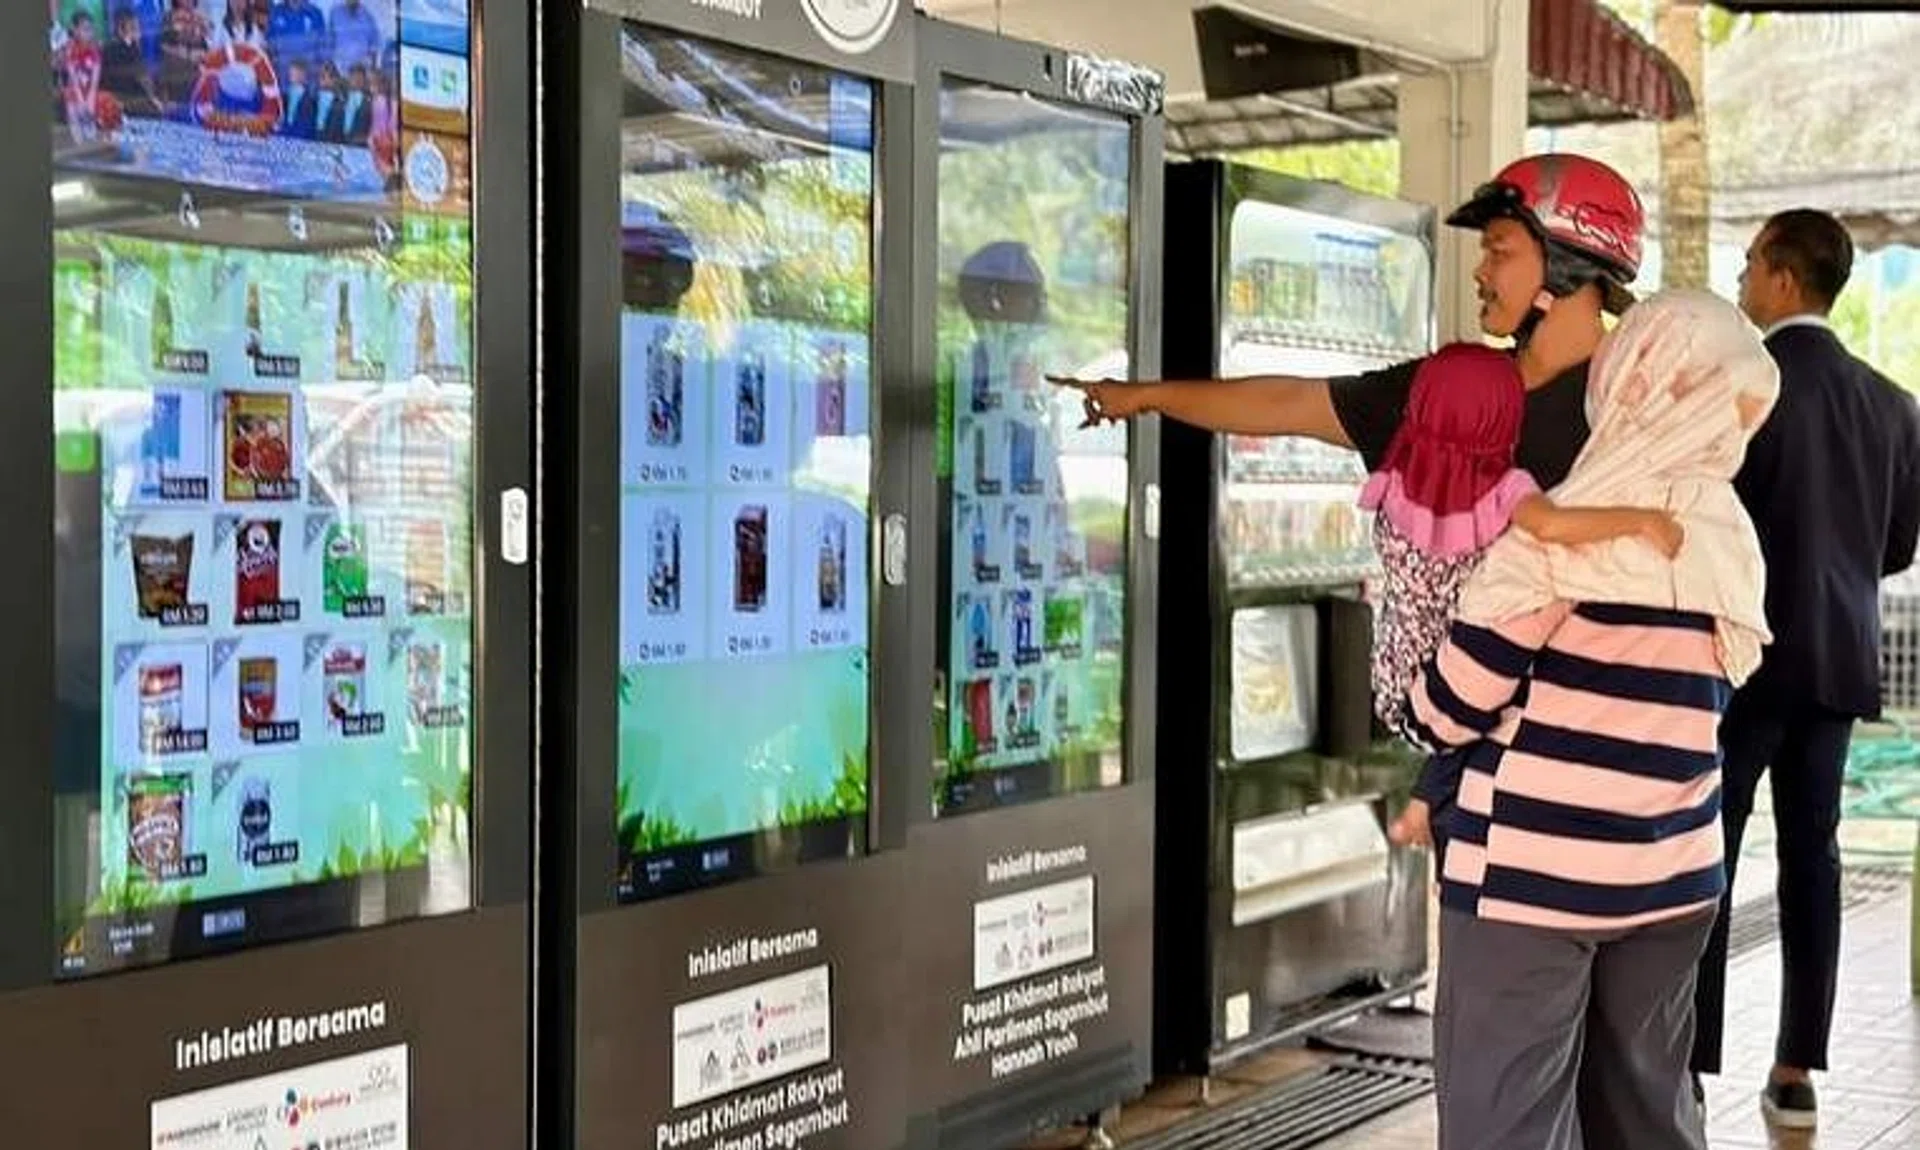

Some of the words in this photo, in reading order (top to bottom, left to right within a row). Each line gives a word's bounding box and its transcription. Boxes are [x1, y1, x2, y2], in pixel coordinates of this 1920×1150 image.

[688, 939, 748, 978] Inisiatif
[750, 928, 818, 962] Bersama
[963, 994, 1002, 1027] Pusat
[1003, 978, 1058, 1013] Khidmat
[176, 1018, 274, 1069] Inisiatif
[277, 1000, 386, 1047] Bersama
[656, 1112, 710, 1150] Pusat
[711, 1087, 785, 1131] Khidmat
[787, 1068, 843, 1108] Rakyat
[765, 1099, 848, 1149] Segambut
